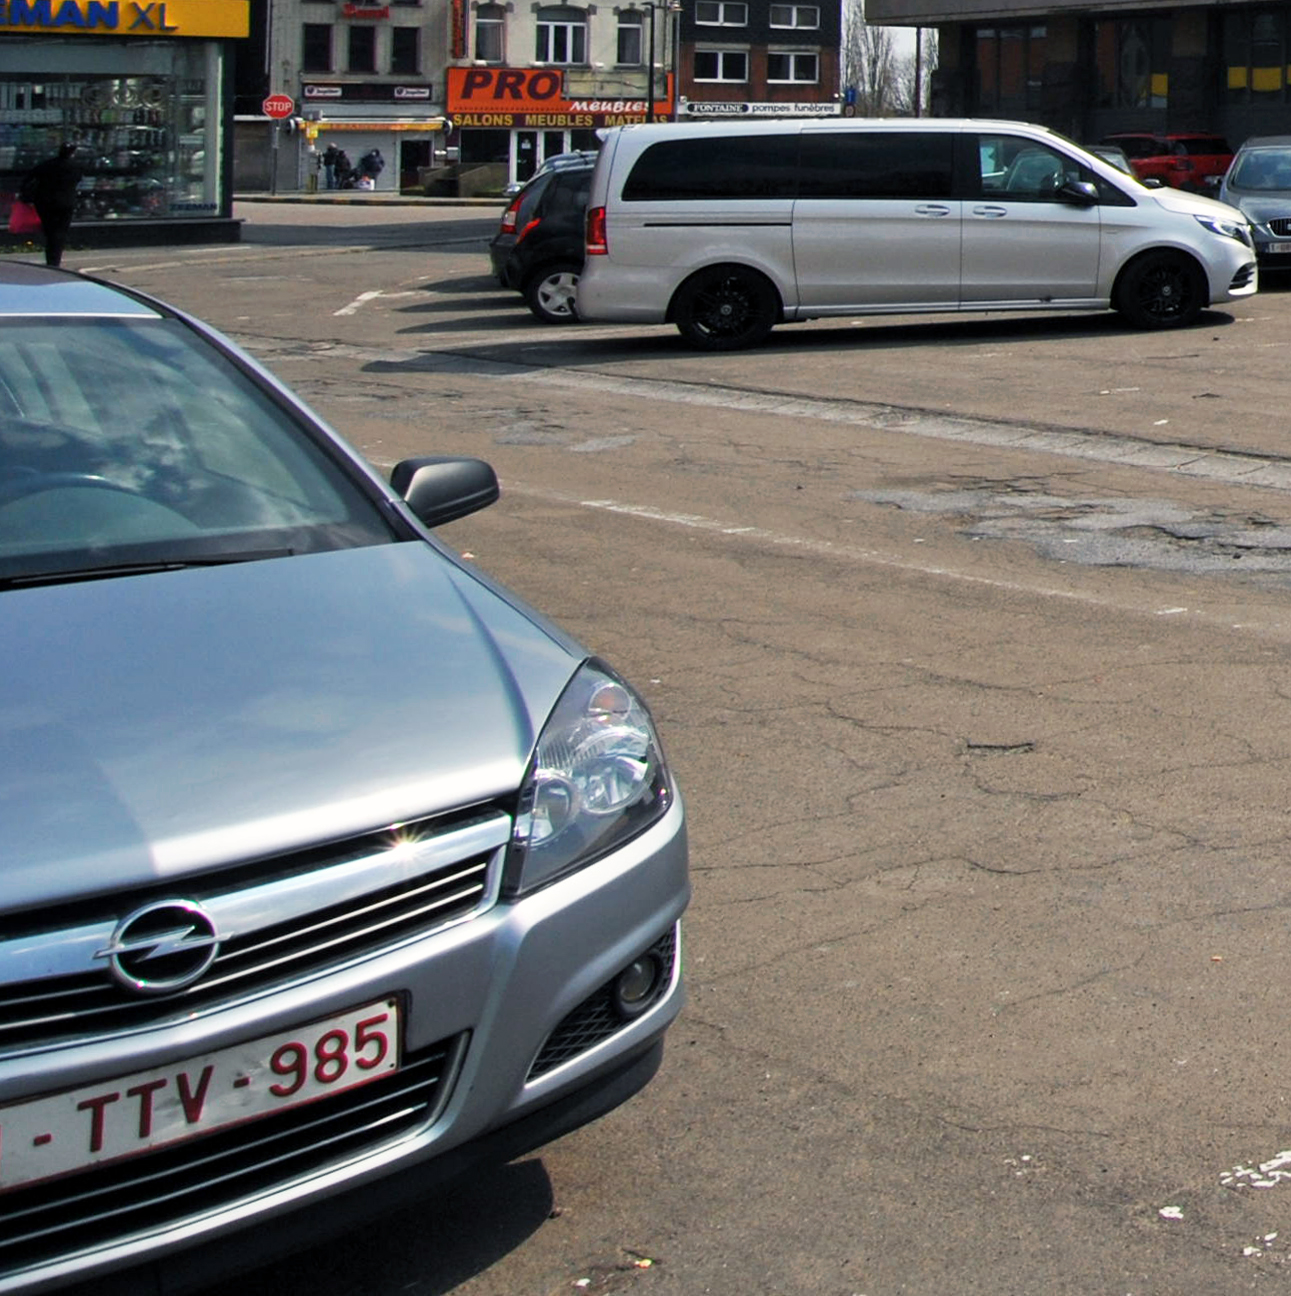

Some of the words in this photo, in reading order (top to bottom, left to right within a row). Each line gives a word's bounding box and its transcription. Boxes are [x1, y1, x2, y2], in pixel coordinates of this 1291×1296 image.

[129, 2, 179, 31] XL
[461, 70, 560, 100] PRO
[265, 101, 292, 112] STOP
[693, 104, 743, 113] FONTAINE
[752, 104, 791, 114] pompes
[794, 102, 835, 113] funèbres
[453, 114, 513, 126] SALONS
[525, 114, 593, 126] MEUBLES
[0, 1012, 389, 1163] -TTV-985
